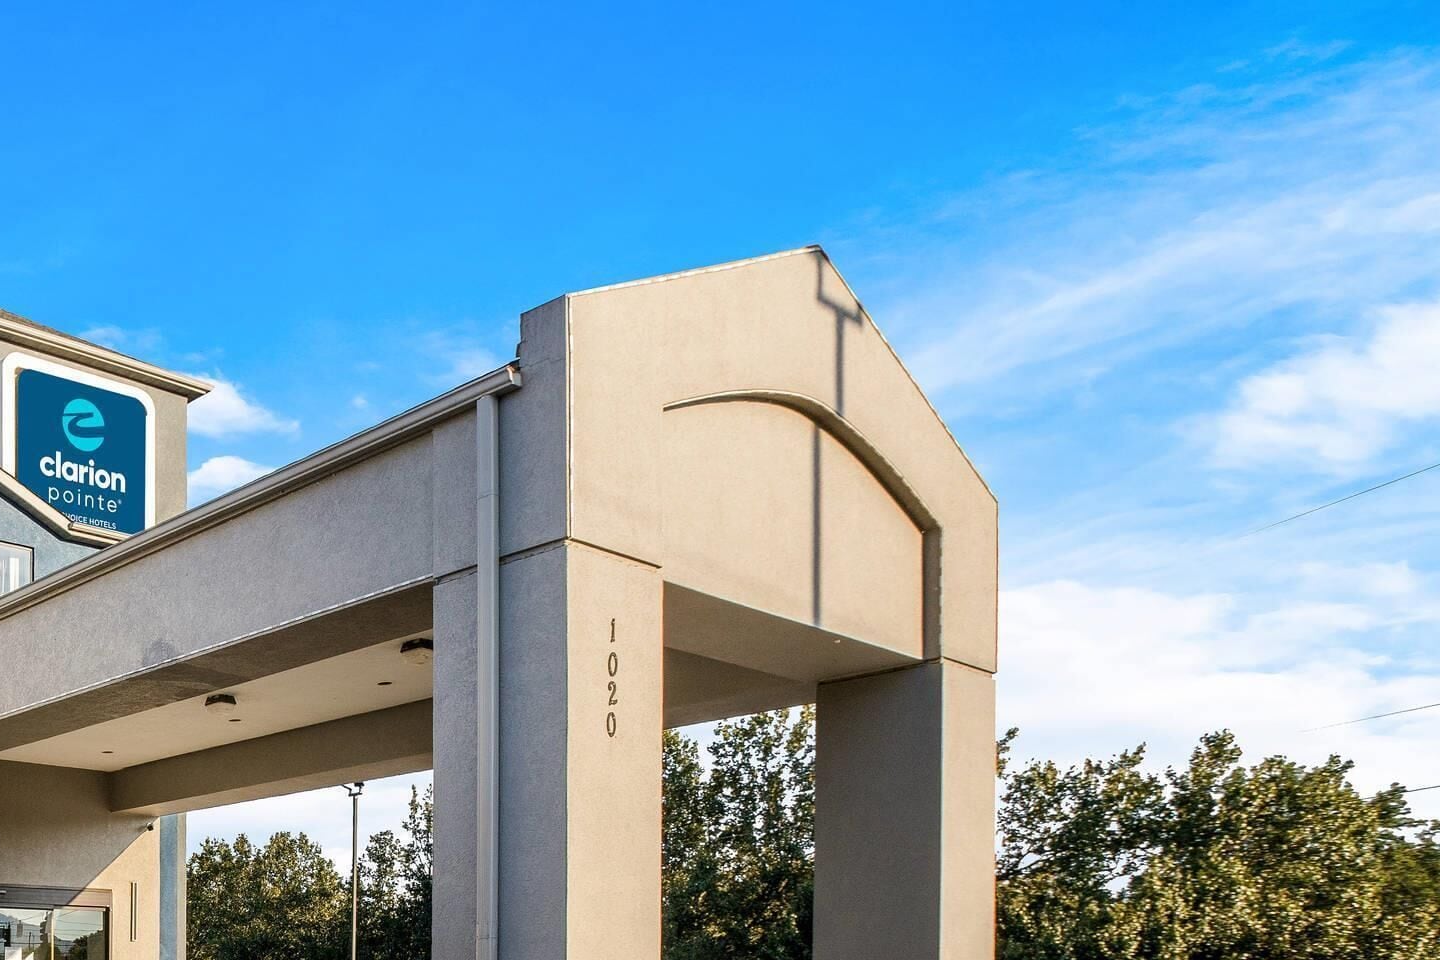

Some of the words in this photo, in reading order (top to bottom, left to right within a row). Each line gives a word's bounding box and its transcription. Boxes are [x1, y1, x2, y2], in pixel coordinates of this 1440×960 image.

[39, 451, 126, 493] clarion
[89, 517, 117, 529] HOTELS
[606, 618, 618, 738] 1020
